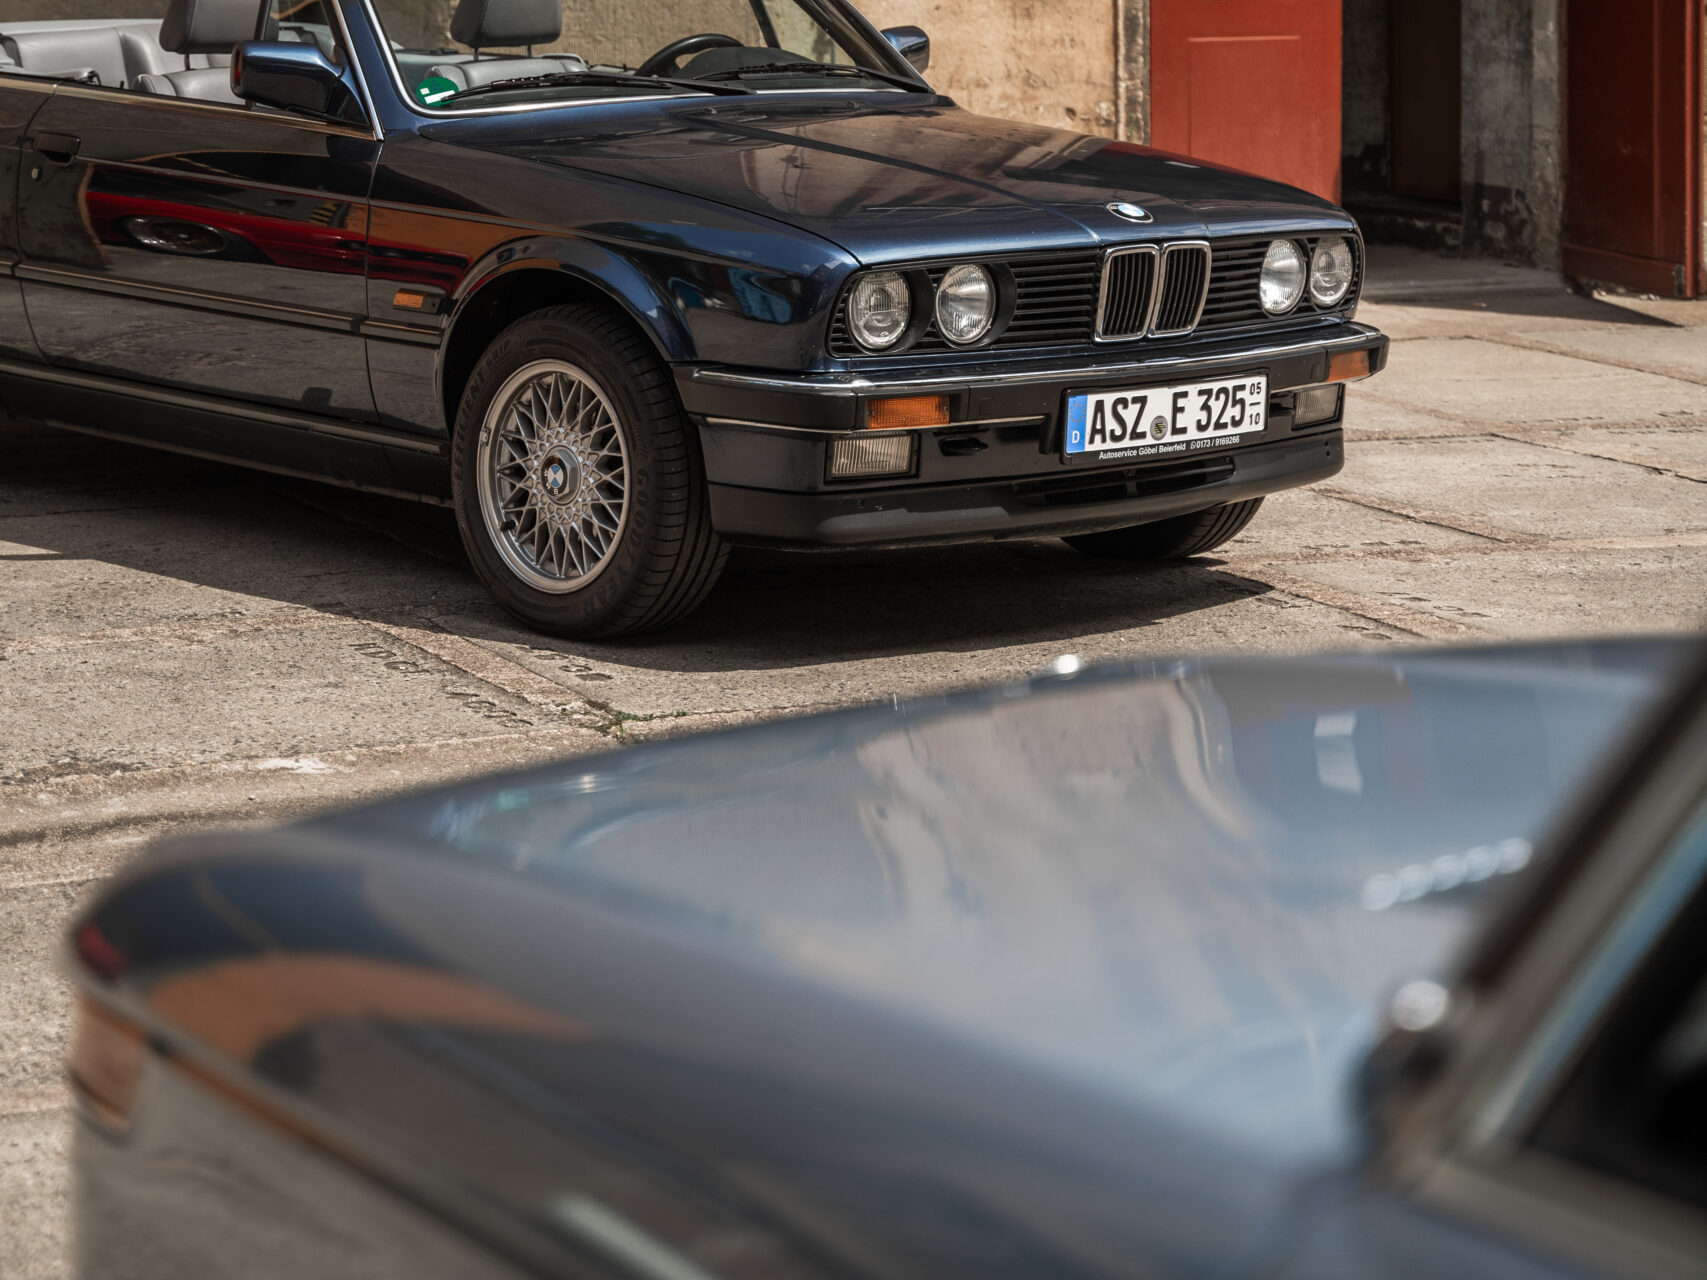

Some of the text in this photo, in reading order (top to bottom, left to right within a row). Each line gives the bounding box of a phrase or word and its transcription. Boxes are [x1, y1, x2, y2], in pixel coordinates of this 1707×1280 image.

[1249, 381, 1262, 396] 05
[1088, 384, 1247, 445] ASZ E 325
[1249, 412, 1261, 426] 10
[1072, 431, 1080, 444] D
[1098, 449, 1138, 460] Autoservice
[1138, 446, 1158, 456] Göbel
[1159, 443, 1186, 454] Beierfeld
[1196, 439, 1211, 449] 0173
